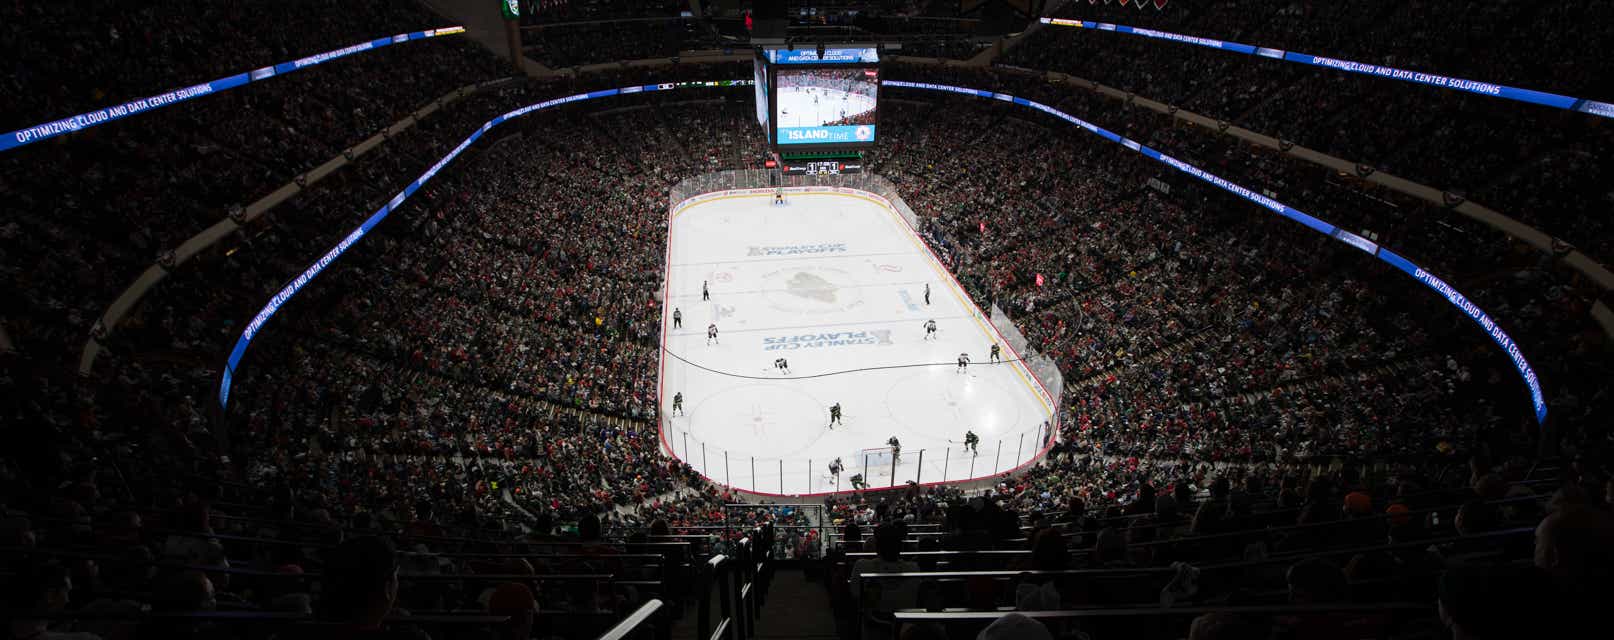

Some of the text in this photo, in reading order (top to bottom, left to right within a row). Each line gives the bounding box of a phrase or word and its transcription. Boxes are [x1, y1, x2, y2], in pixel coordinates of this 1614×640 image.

[1312, 56, 1500, 95] OPTIMIZING CLOUD AND DATA CENTER SOLUTIONS
[15, 84, 212, 143] OPTIMIZING CLOUD AND DATA CENTER SOLUTIONS
[789, 130, 828, 139] ISLAND
[1186, 164, 1201, 179] CLOUD
[1202, 171, 1213, 182] AND
[1214, 176, 1228, 188] DATA
[1228, 182, 1250, 197] CENTER
[1250, 191, 1285, 213] SOLUTIONS
[273, 286, 294, 308] CLOUD
[294, 274, 307, 290] AND
[306, 262, 321, 278] DATA
[320, 247, 340, 268] CENTER
[763, 331, 866, 344] PLAYOFFS
[1415, 268, 1457, 302] OPTIMIZING
[1456, 296, 1479, 318] CLOUD
[1479, 311, 1493, 331] AND
[1493, 326, 1509, 347] DATA
[1509, 343, 1527, 372] CENTER
[764, 336, 875, 351] STANLEY CUP
